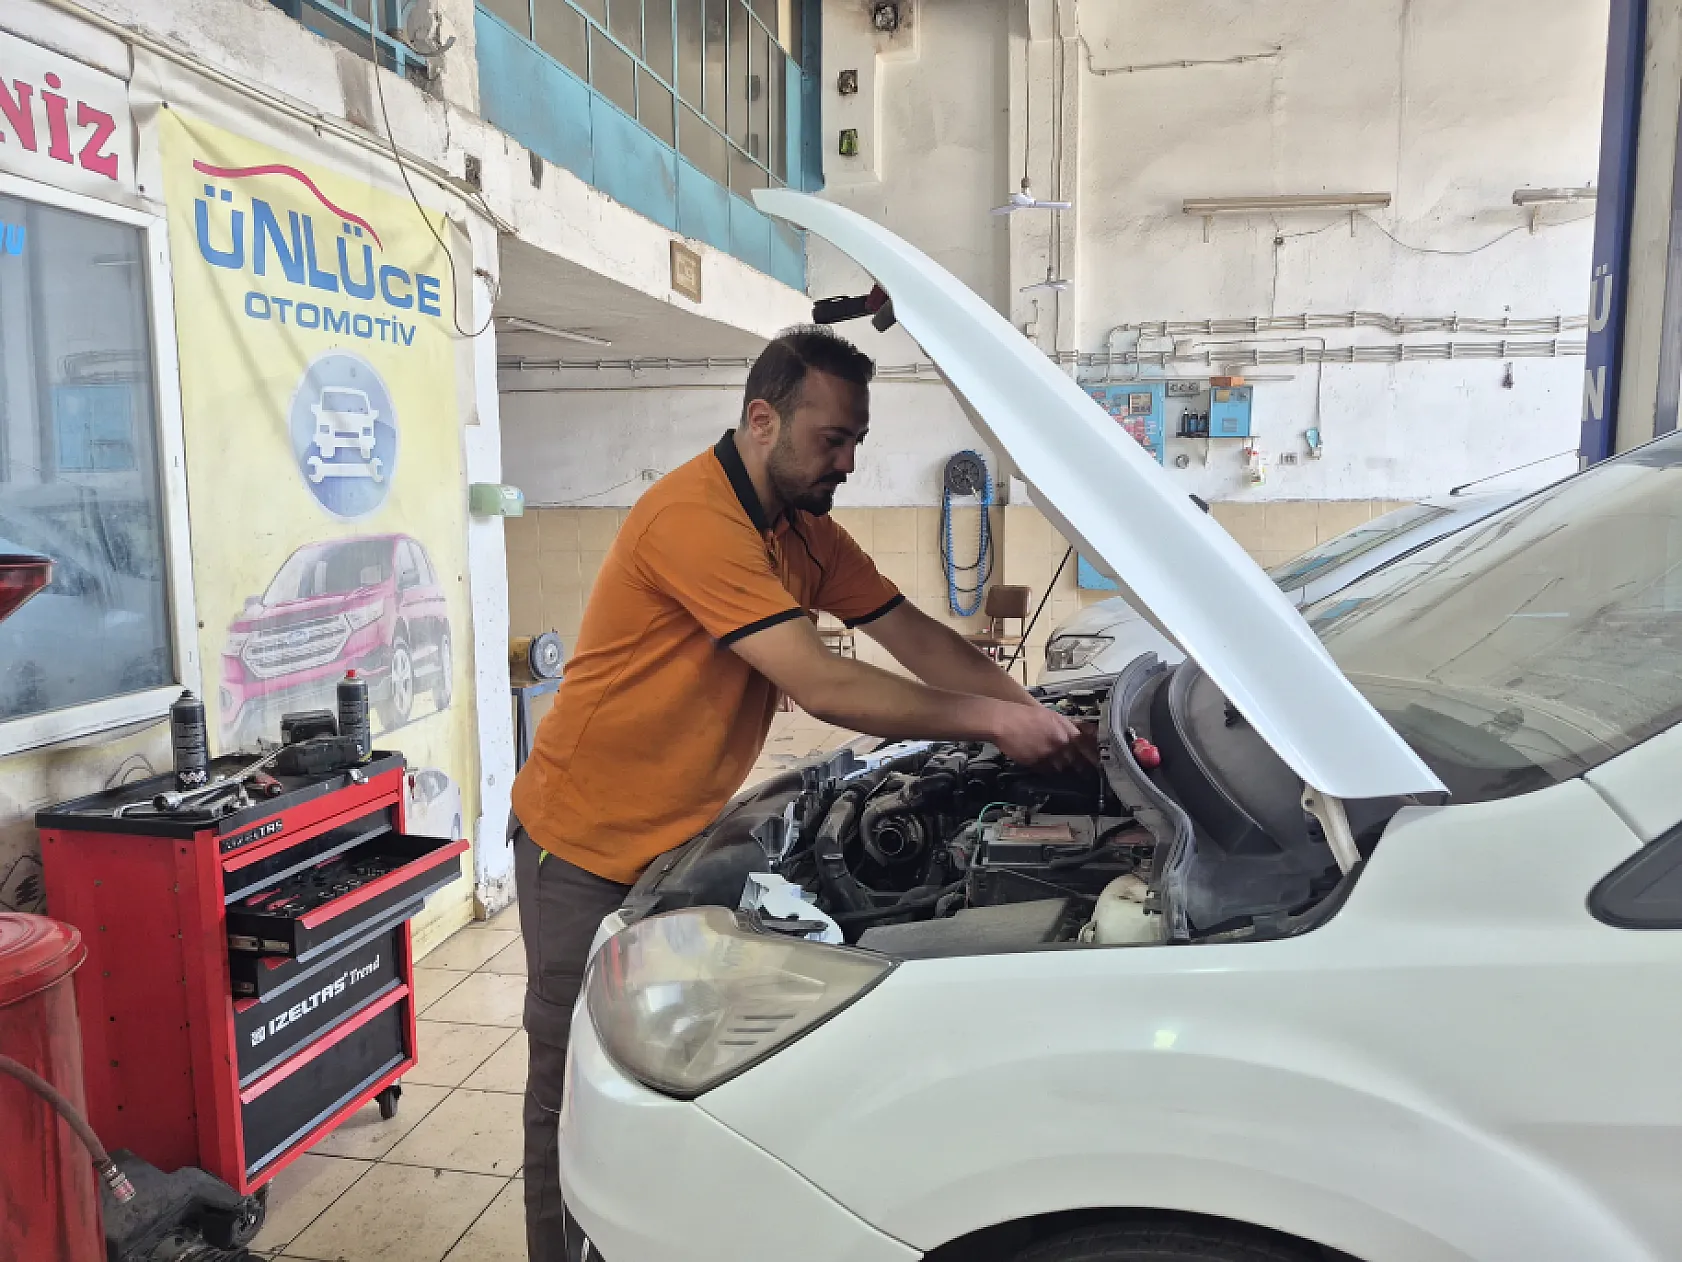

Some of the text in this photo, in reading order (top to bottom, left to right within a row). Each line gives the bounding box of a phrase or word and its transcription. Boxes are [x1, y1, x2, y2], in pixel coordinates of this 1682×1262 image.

[0, 220, 26, 257] U
[194, 183, 442, 318] ÜNLÜCE
[244, 291, 417, 347] OTOMOTİV
[1578, 263, 1612, 471] ÜN
[349, 953, 380, 985] Trend
